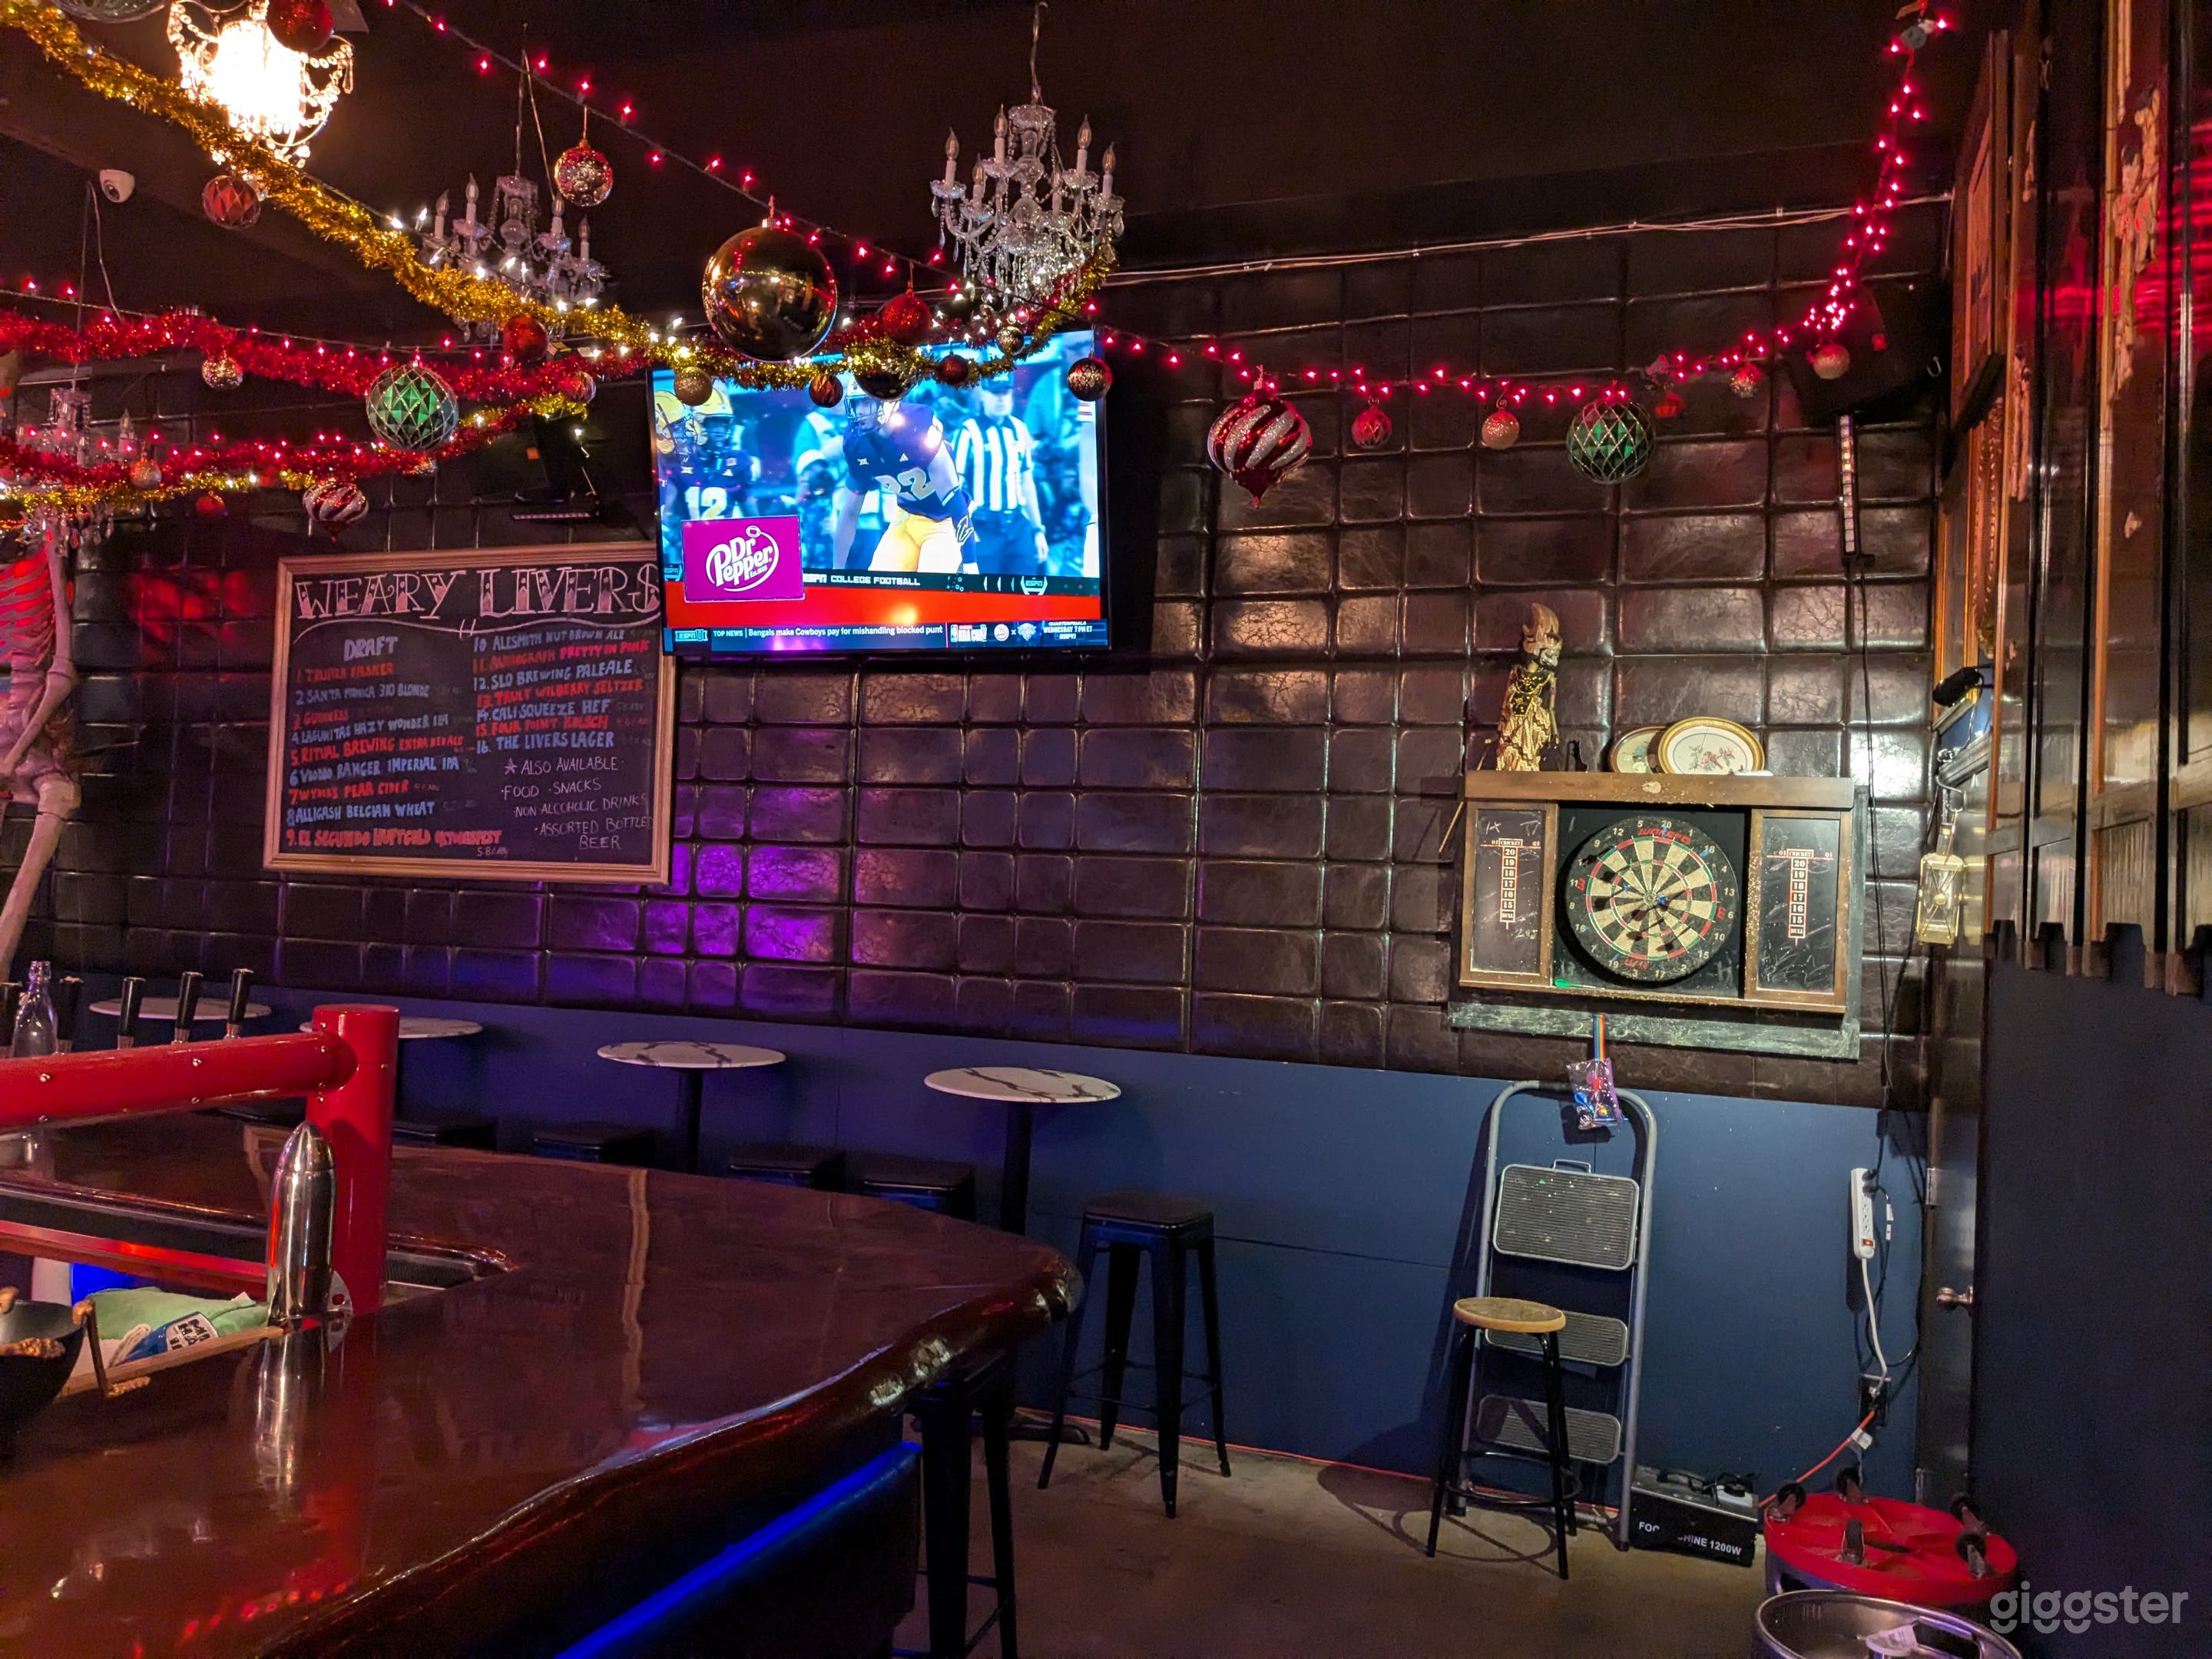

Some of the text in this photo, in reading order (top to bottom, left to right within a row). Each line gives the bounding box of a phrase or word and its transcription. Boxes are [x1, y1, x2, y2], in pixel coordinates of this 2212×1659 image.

[684, 486, 727, 519] 12
[730, 537, 756, 560] Dr
[707, 543, 773, 587] Pepper
[803, 574, 920, 586] ESPN COLLEGE FOOTBALL
[295, 563, 661, 619] WEARY LIVERS
[568, 628, 603, 641] BROWN
[606, 629, 625, 640] ALE
[749, 628, 774, 639] Bengals
[796, 627, 826, 637] Cowboys
[827, 628, 839, 637] pay
[853, 626, 895, 636] mishandling
[896, 625, 924, 634] blocked
[926, 625, 942, 634] punt
[344, 635, 399, 661] DRAFT
[559, 645, 603, 660] PRETTY
[604, 644, 618, 654] IN
[620, 640, 651, 653] PINK
[516, 666, 571, 686] BREWING
[306, 688, 341, 704] SANTA
[397, 683, 430, 698] BLONDE
[593, 678, 643, 695] SELTZER
[518, 702, 575, 719] SQUEEZE
[582, 699, 611, 714] HEF
[354, 720, 384, 736] HAZY
[388, 714, 429, 731] WONDER
[496, 734, 520, 750] THE
[525, 731, 569, 750] LIVERS
[571, 731, 614, 749] LAGER
[301, 745, 339, 763] RITUAL
[343, 737, 396, 758] BREWING
[337, 760, 381, 779] RANGER
[388, 757, 437, 773] IMPERIAL
[442, 756, 459, 770] IPA
[521, 757, 618, 775] ALSO AVAILABLE
[344, 781, 374, 798] PEAR
[377, 778, 409, 795] CIDER
[346, 803, 392, 819] BELGIAN
[395, 801, 435, 818] WHEAT
[602, 794, 647, 811] DRINKS
[539, 820, 599, 836] ASSORTED
[1613, 827, 1624, 836] 12
[1637, 820, 1644, 828] 5
[579, 835, 621, 850] BEER
[1721, 865, 1727, 873] 4
[1793, 870, 1805, 879] 19
[1570, 879, 1578, 887] 11
[1724, 888, 1735, 896] 13
[1575, 923, 1585, 932] 16
[1714, 932, 1725, 941] 10
[1698, 949, 1710, 959] 15
[1608, 960, 1619, 969] 19
[1681, 964, 1687, 972] 2
[1632, 969, 1638, 978] 3
[1655, 970, 1665, 979] 17
[1709, 1540, 1742, 1555] 1200W
